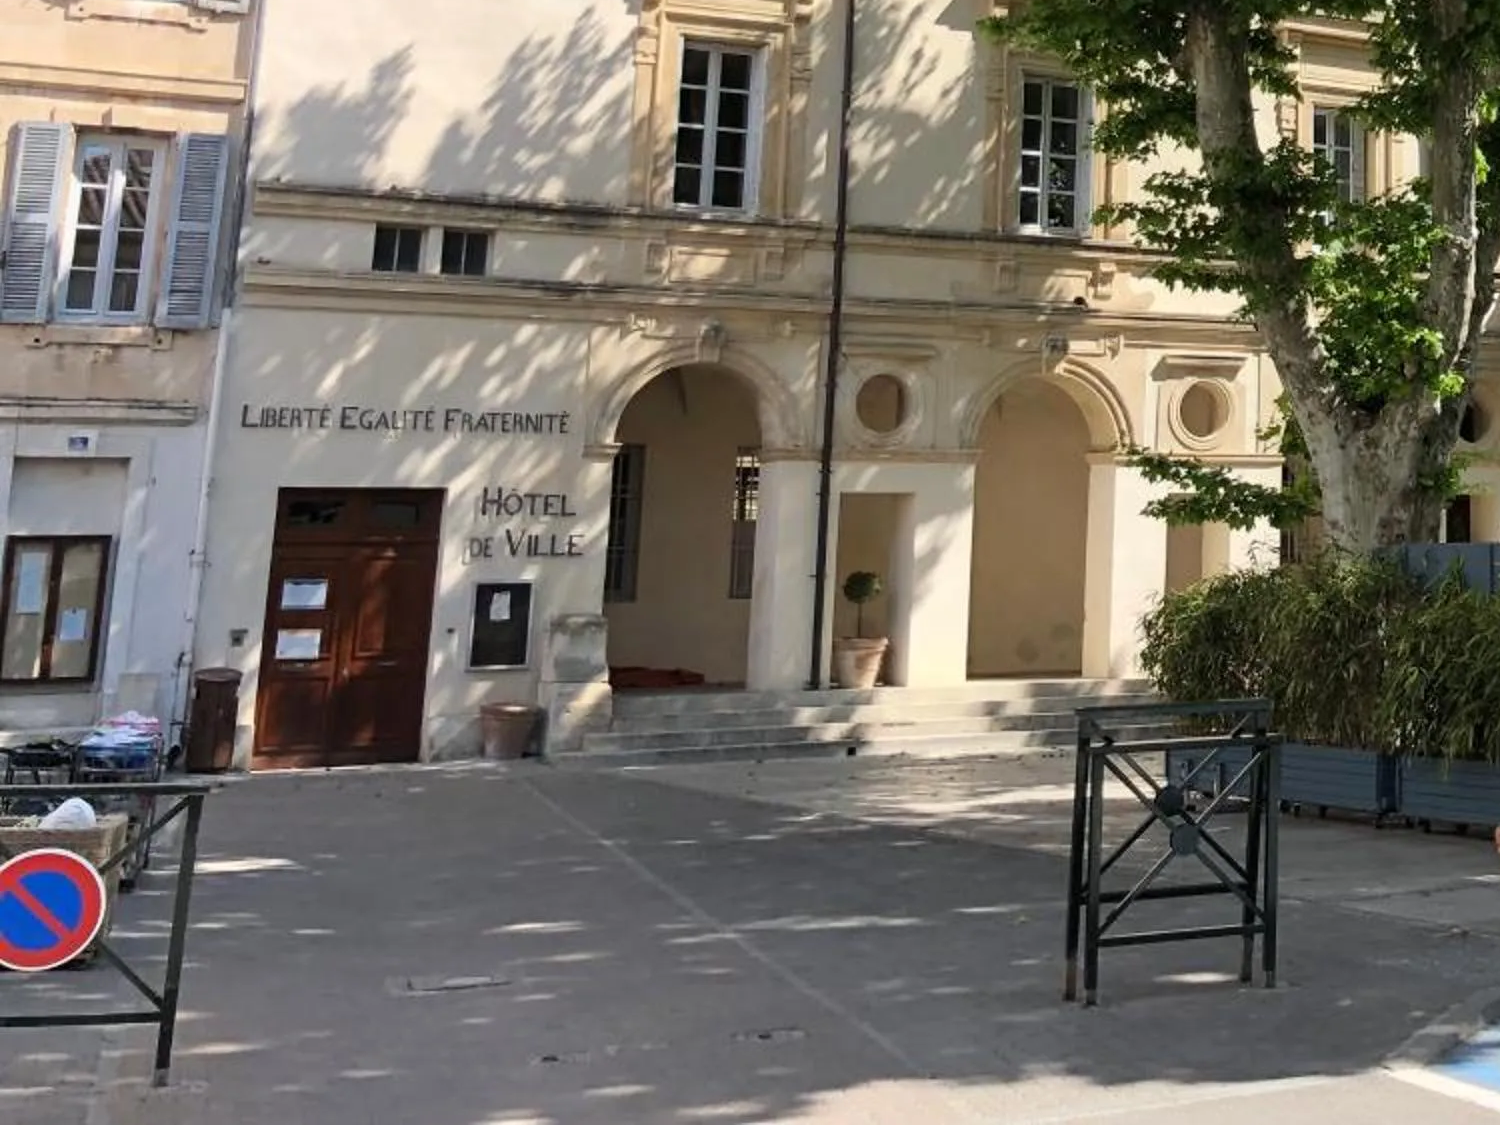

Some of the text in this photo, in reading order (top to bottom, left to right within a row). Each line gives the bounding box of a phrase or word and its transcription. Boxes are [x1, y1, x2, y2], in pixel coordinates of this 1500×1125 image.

[241, 403, 331, 428] LIBERTÉ
[444, 408, 571, 434] FRATERNITÉ
[481, 486, 577, 516] HÔTEL
[468, 529, 585, 558] DE VILLE
